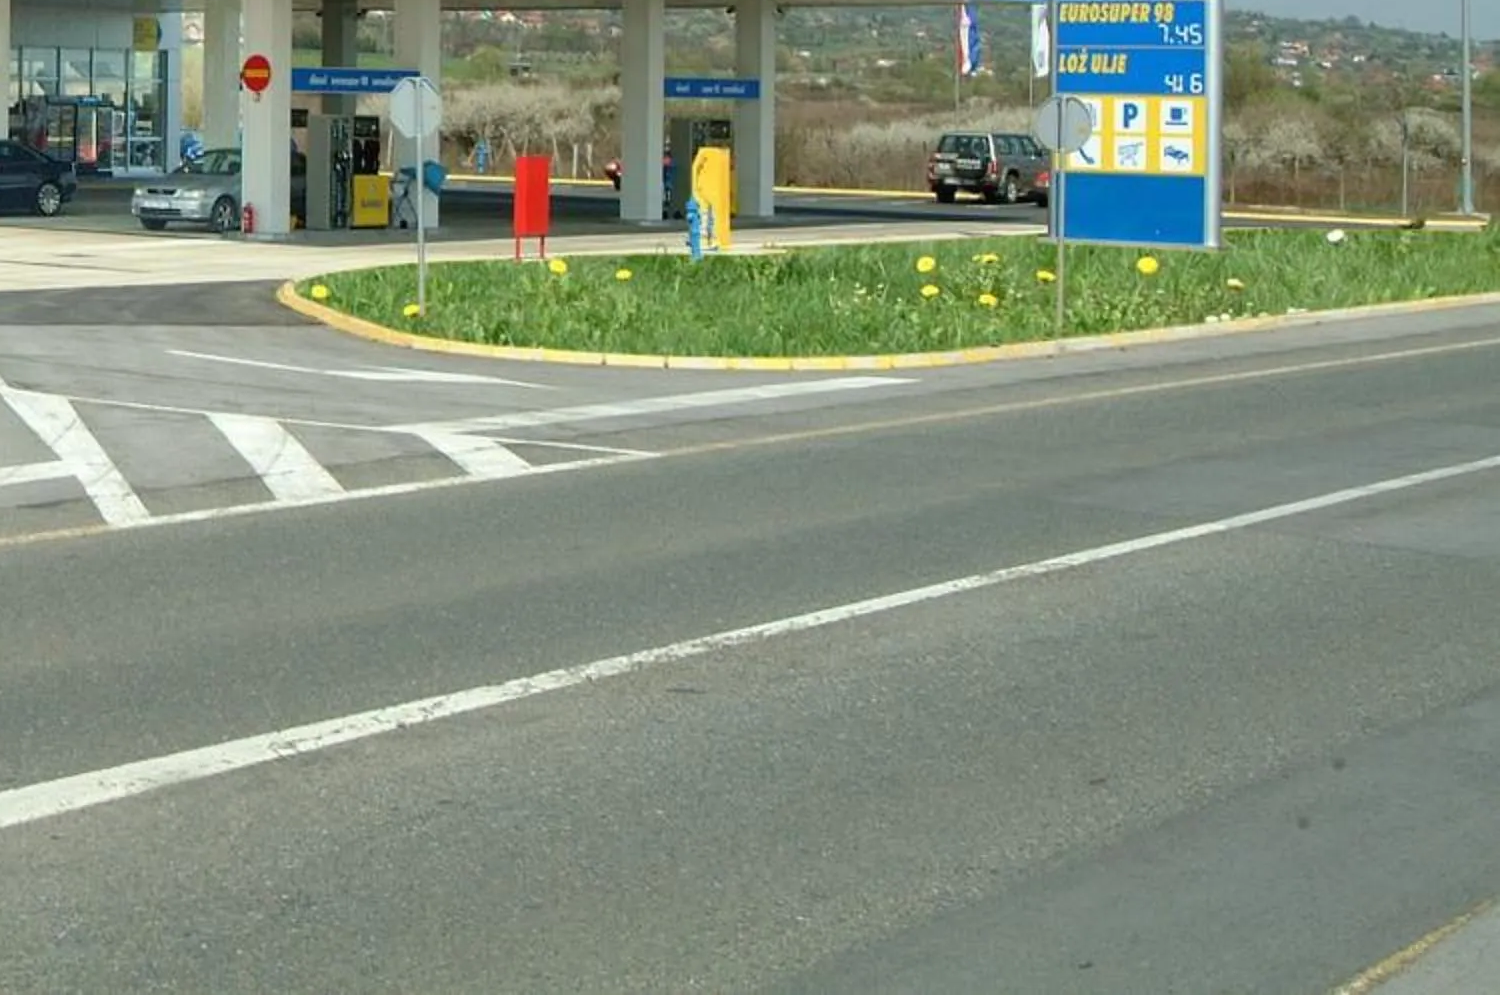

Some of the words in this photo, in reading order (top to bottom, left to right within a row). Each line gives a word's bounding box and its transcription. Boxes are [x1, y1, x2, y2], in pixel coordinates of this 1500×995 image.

[1059, 3, 1150, 23] EUROSUPER
[1153, 2, 1175, 23] 98
[1157, 23, 1203, 44] 7.45
[1058, 46, 1088, 73] LOŽ
[1090, 53, 1127, 74] ULJE
[1122, 102, 1139, 128] P
